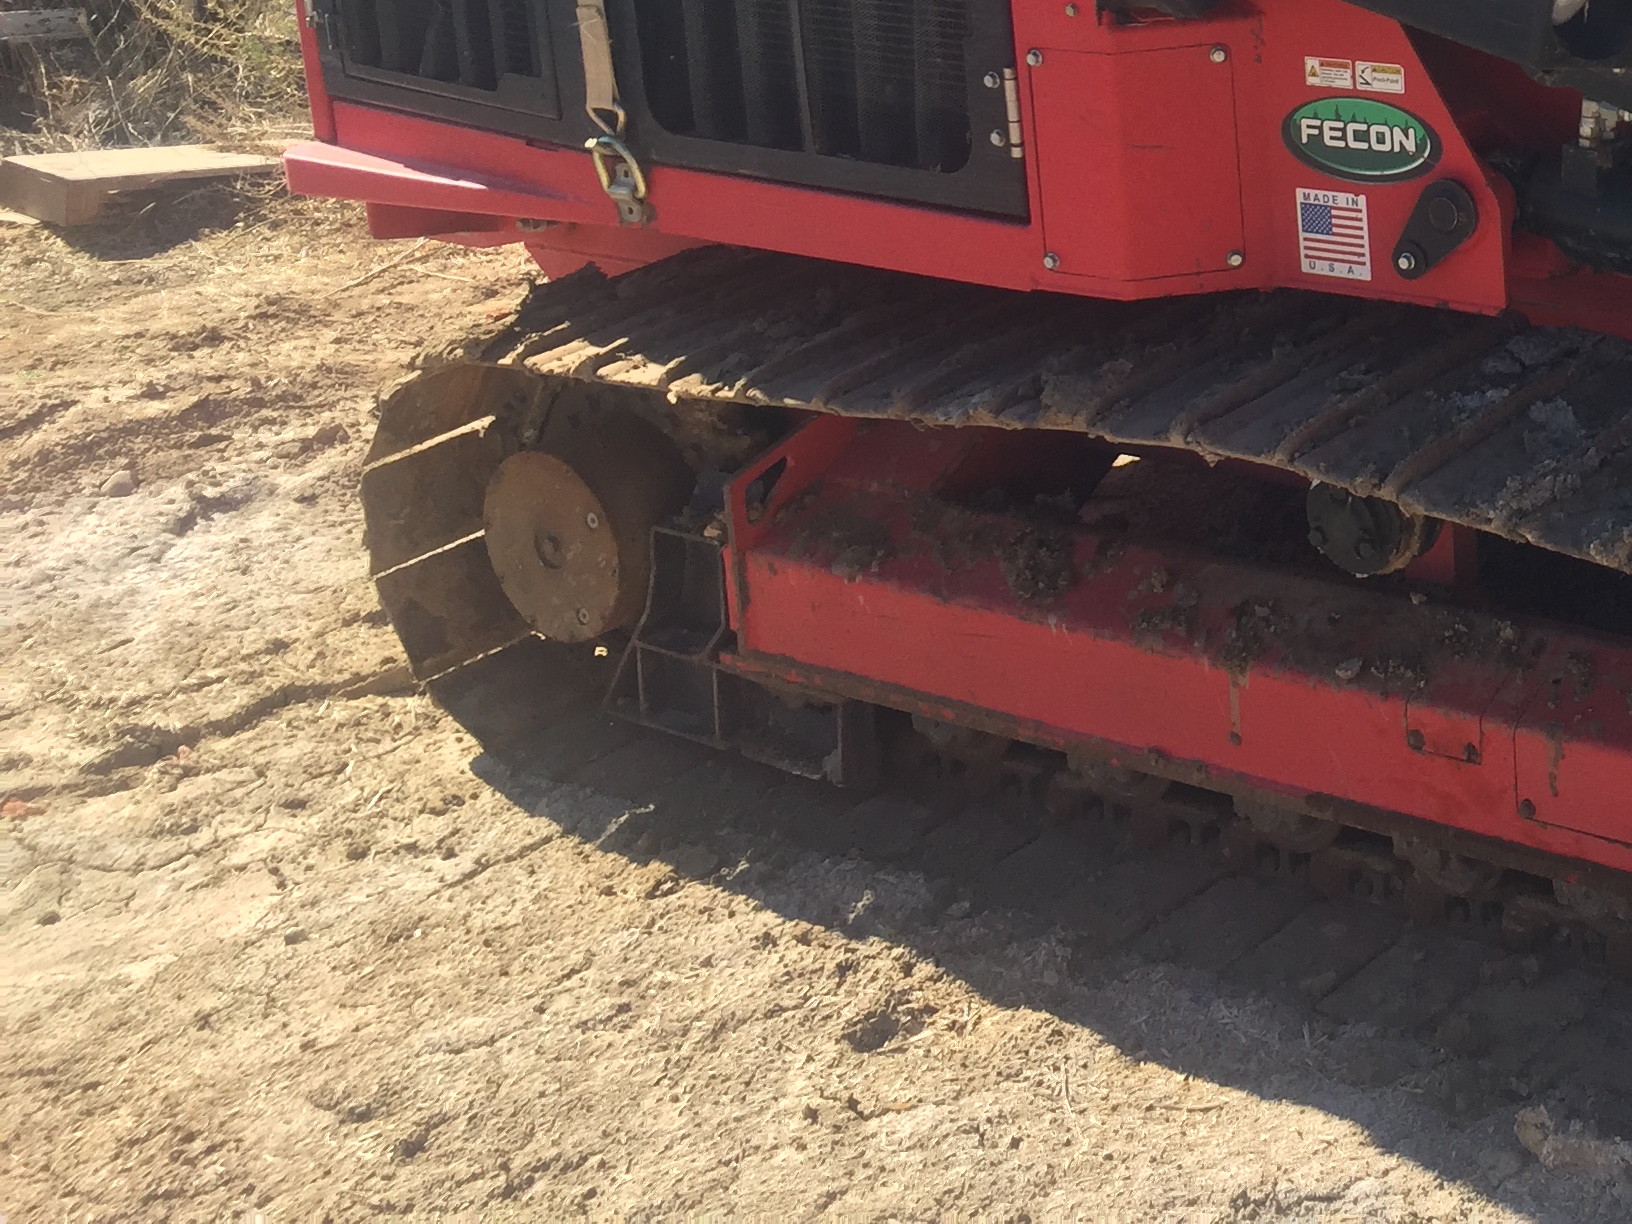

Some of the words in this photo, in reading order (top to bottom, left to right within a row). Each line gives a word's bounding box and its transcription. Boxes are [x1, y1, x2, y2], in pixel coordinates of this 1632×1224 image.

[1300, 117, 1417, 155] FECON
[1302, 191, 1340, 206] MADE
[1345, 196, 1360, 207] IN
